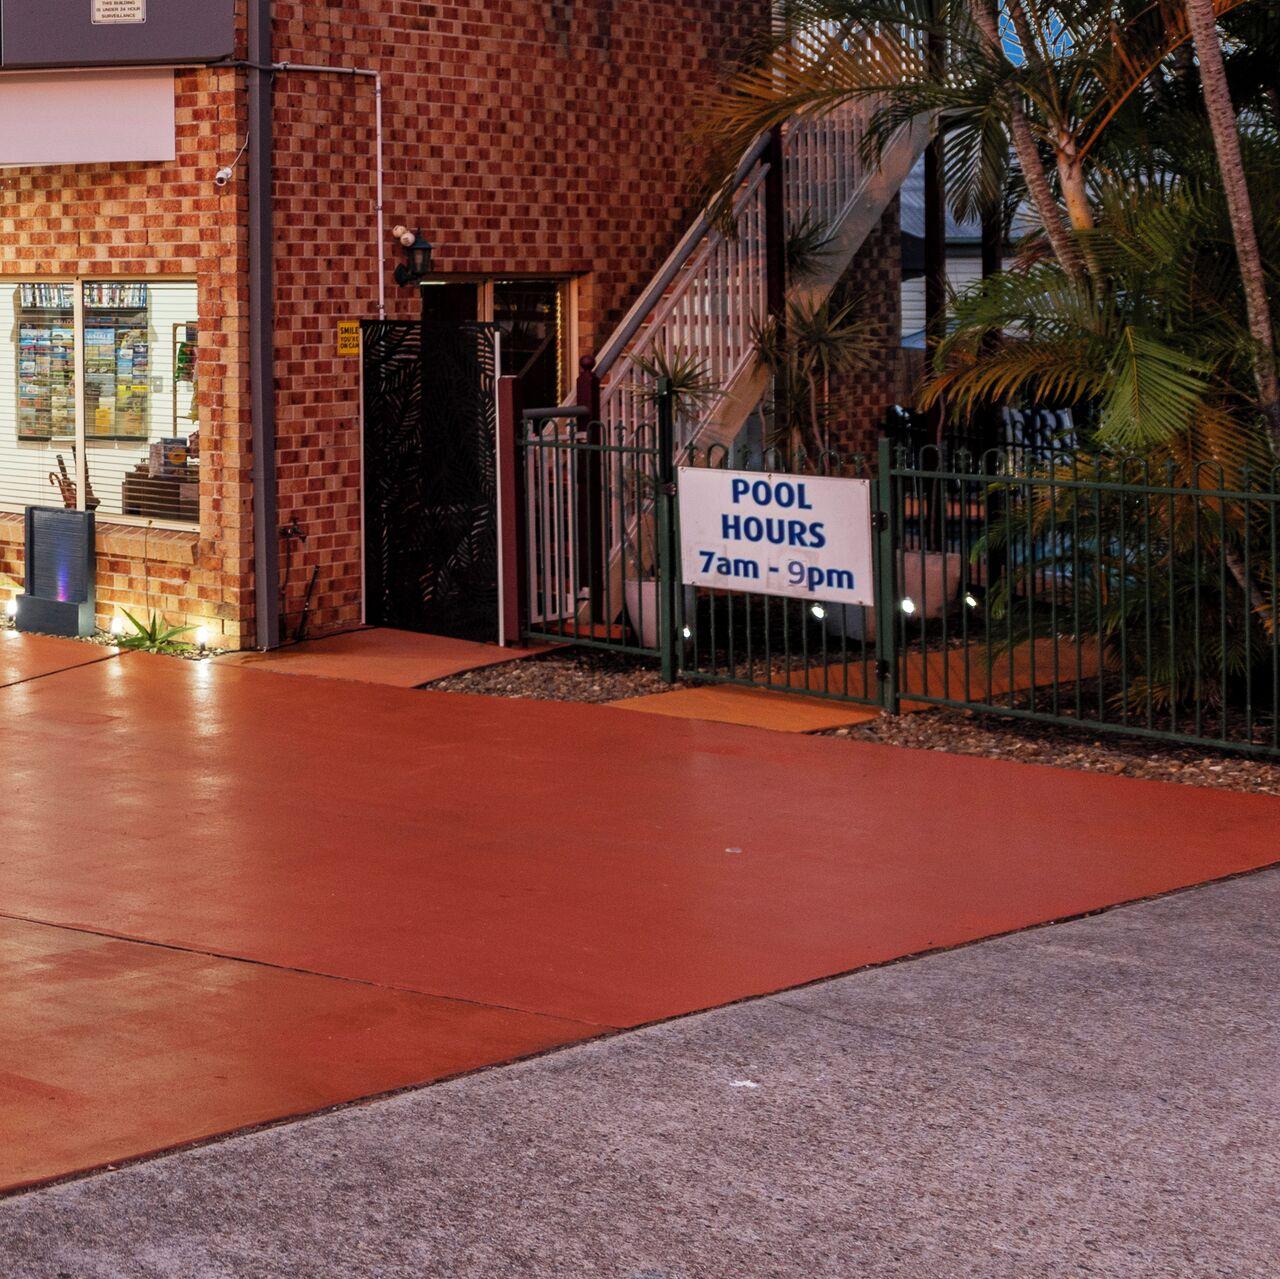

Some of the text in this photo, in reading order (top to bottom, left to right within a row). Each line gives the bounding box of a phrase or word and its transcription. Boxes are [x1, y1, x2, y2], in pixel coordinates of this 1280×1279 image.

[340, 326, 359, 334] SMILE
[731, 478, 812, 510] POOL
[721, 514, 826, 548] HOURS
[699, 550, 759, 579] 7am
[787, 559, 854, 591] 9pm
